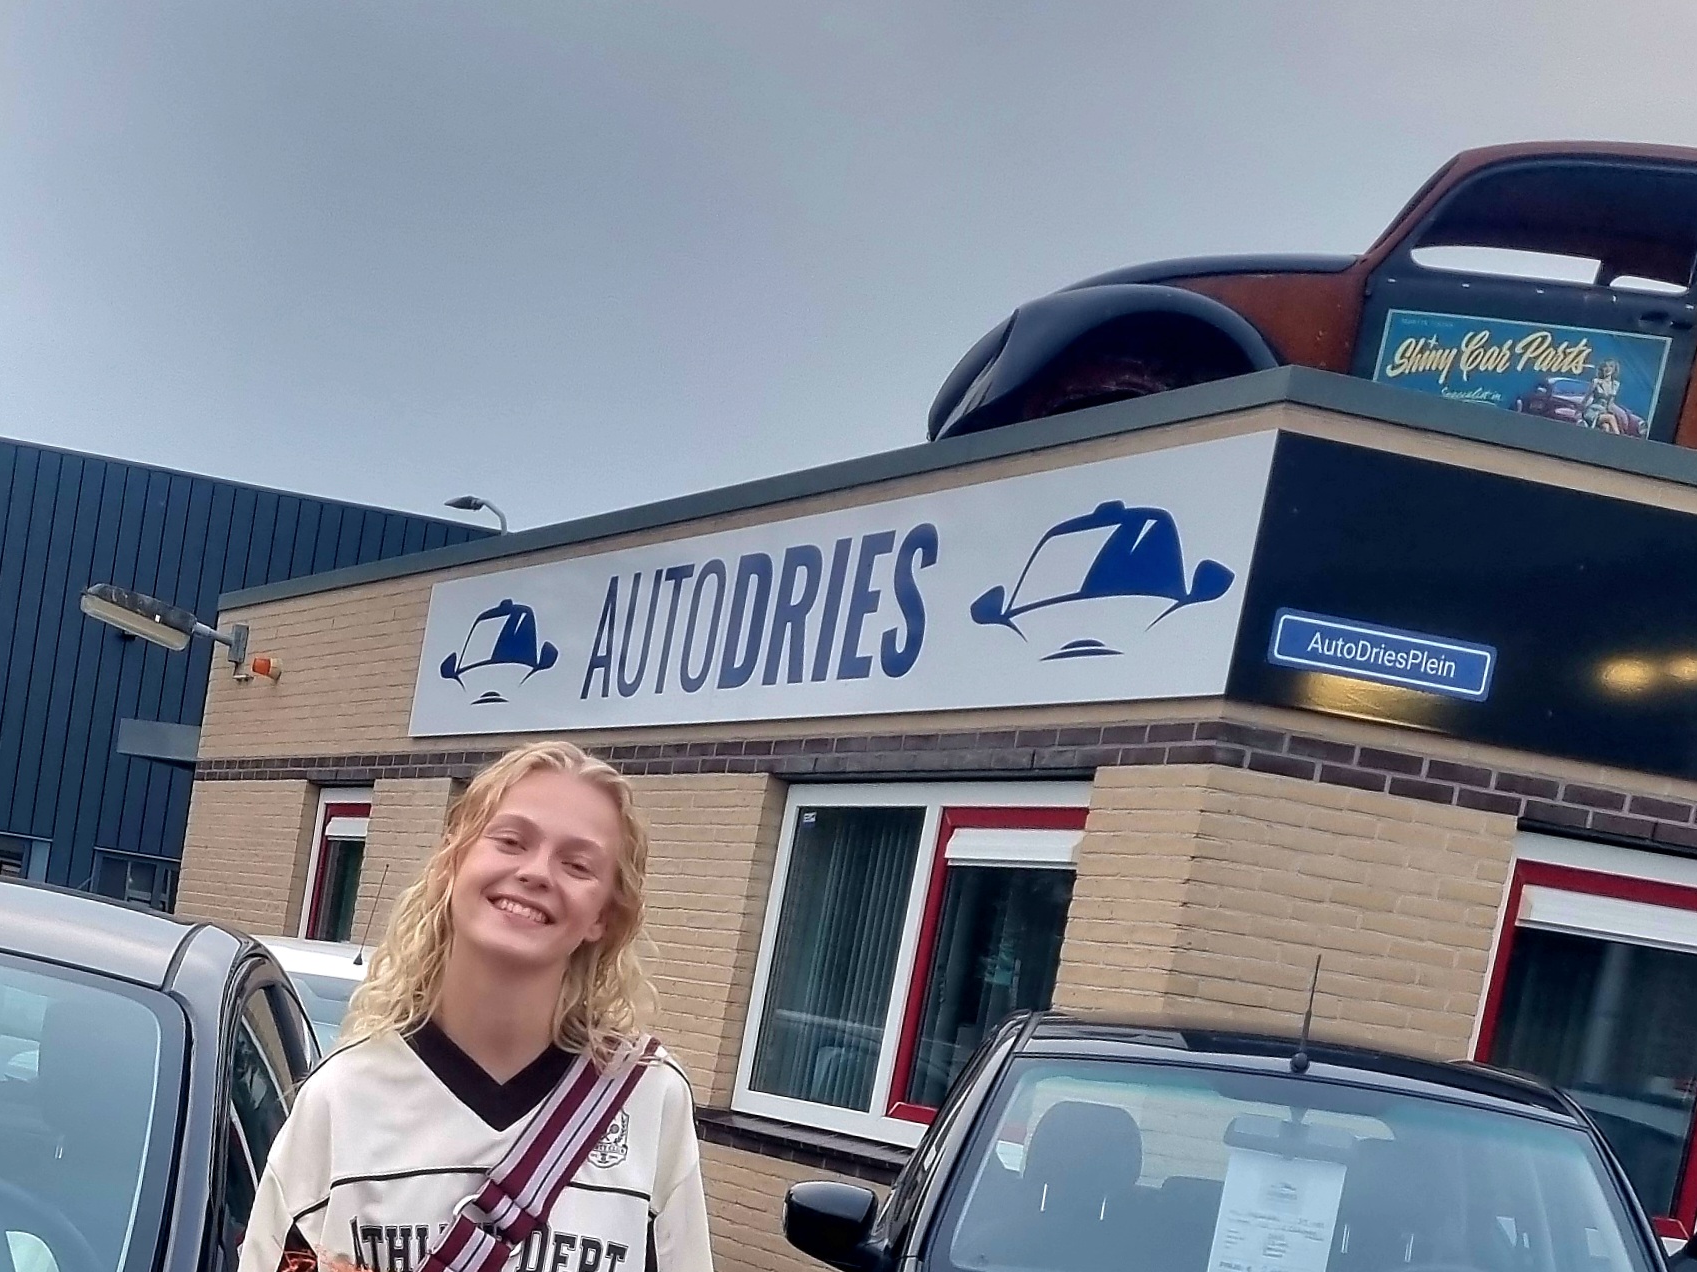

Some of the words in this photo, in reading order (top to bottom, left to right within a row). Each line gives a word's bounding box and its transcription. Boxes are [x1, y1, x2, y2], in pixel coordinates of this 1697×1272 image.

[1386, 334, 1457, 384] Shiny
[1459, 330, 1512, 381] Car
[1515, 330, 1595, 375] Parts
[580, 522, 939, 700] AUTODRIES
[1307, 631, 1456, 678] AutoDriesPlein
